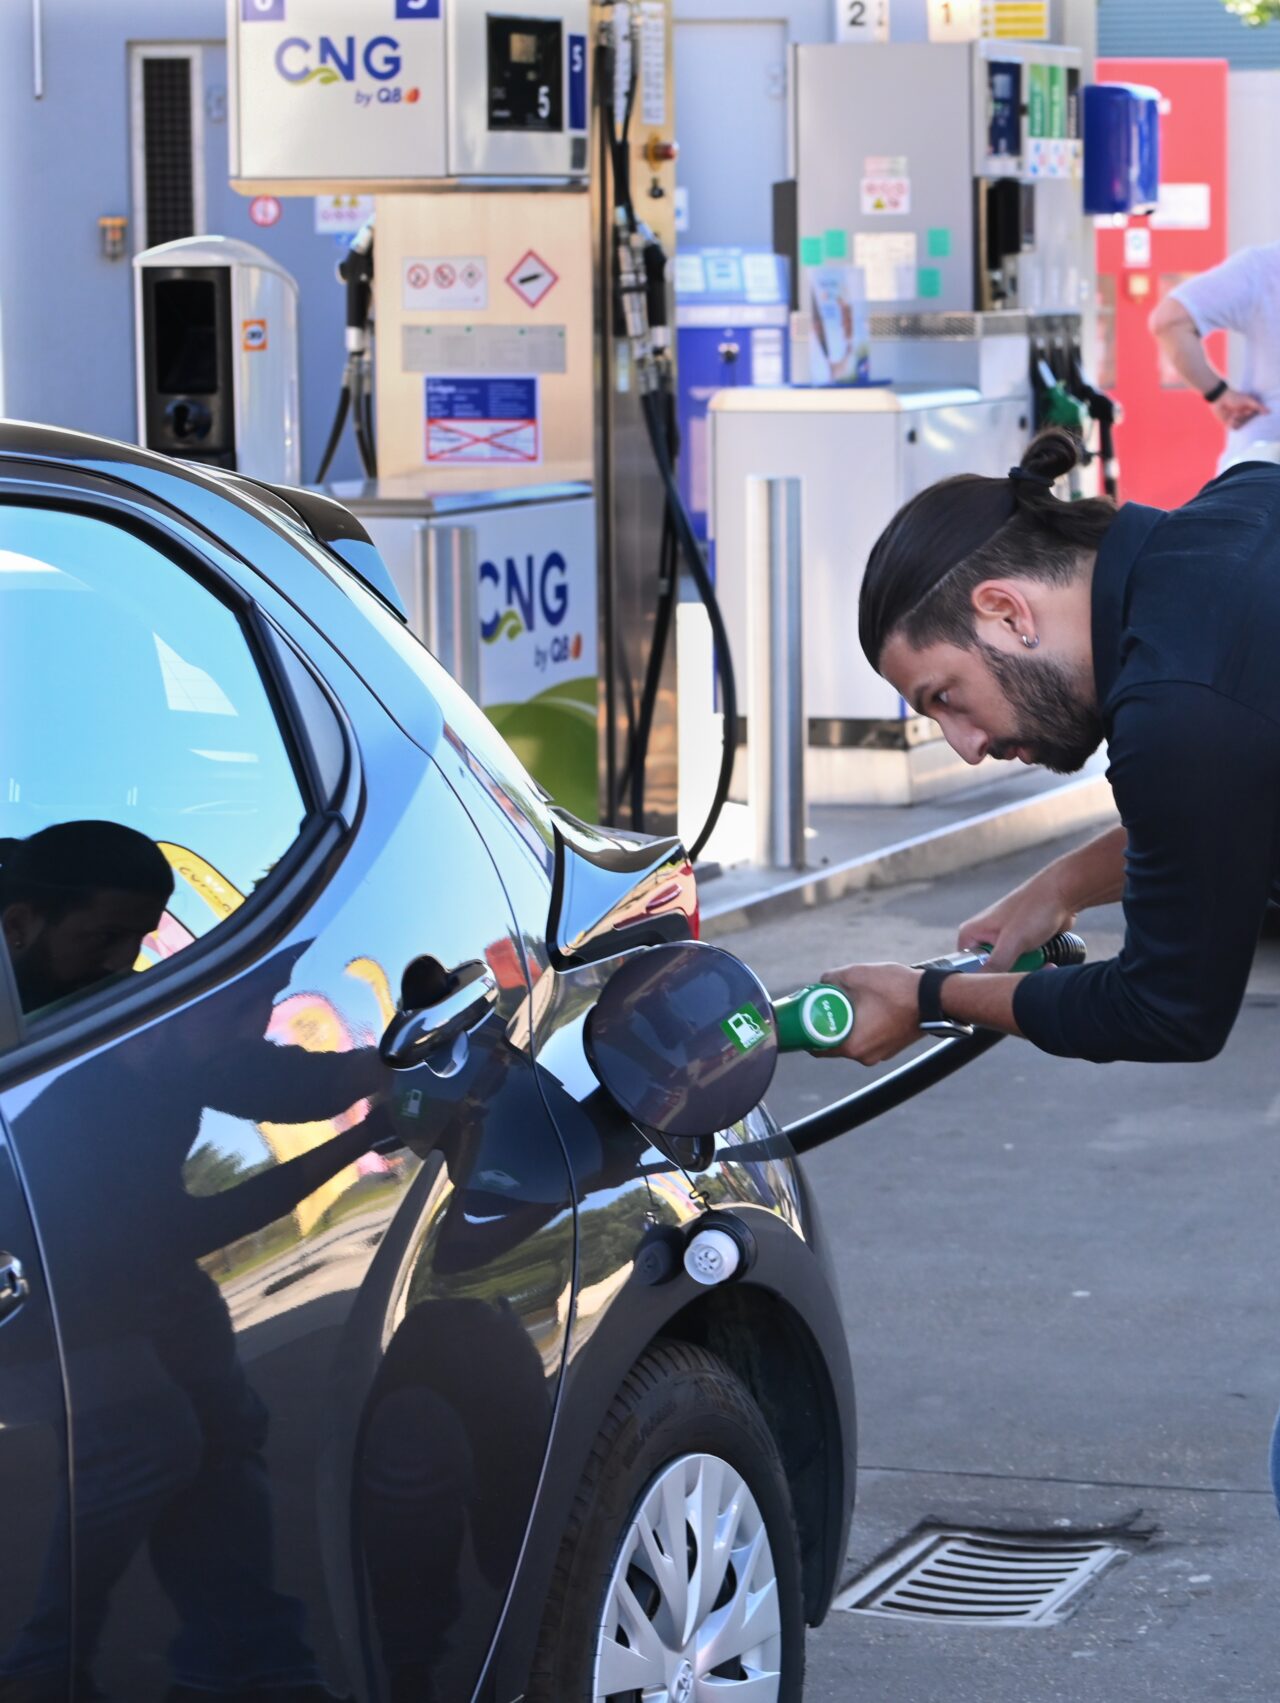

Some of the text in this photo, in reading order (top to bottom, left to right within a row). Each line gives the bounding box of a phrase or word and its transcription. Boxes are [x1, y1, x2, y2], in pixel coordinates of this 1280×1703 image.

[849, 1, 866, 27] 2
[942, 2, 952, 25] 1
[275, 35, 402, 83] CNG
[572, 44, 583, 73] 5
[355, 87, 402, 107] by Q8
[537, 85, 551, 119] 5
[479, 550, 568, 640] CNG
[551, 635, 569, 663] Q8
